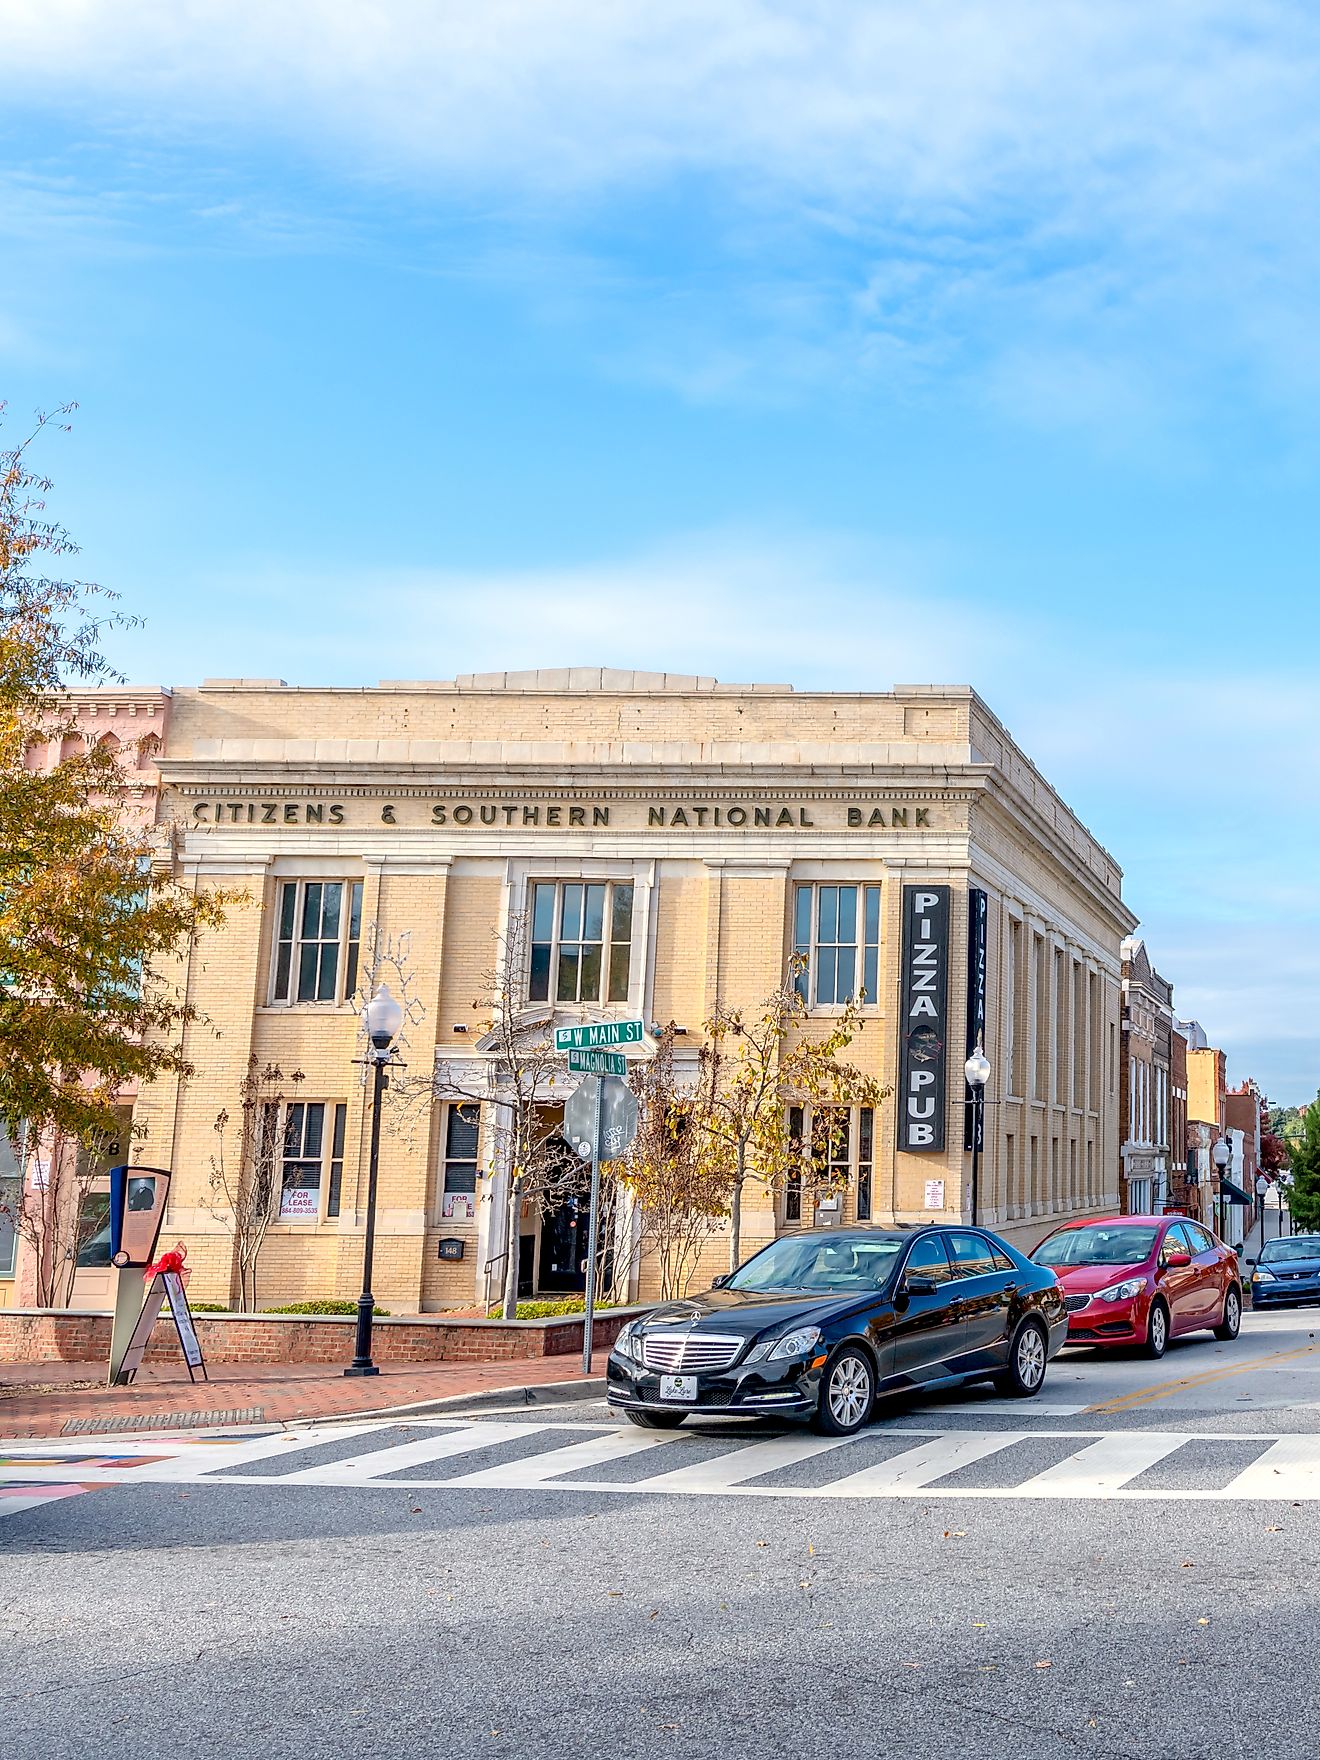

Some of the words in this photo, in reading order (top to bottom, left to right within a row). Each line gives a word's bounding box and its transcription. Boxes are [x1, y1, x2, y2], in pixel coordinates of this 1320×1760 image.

[192, 803, 345, 825] CITIZENS
[381, 804, 397, 825] &
[431, 804, 610, 828] SOUTHERN
[648, 806, 814, 828] NATIONAL
[847, 807, 931, 828] BANK
[909, 892, 940, 1018] PIZZA
[573, 1029, 583, 1047] W
[589, 1025, 620, 1045] MAIN
[626, 1022, 641, 1041] ST
[579, 1051, 616, 1073] MAGNOLIA
[617, 1056, 625, 1074] ST
[907, 1070, 936, 1146] PUB
[288, 1199, 313, 1207] LEASE
[292, 1191, 309, 1199] FOR
[445, 1247, 458, 1255] 148
